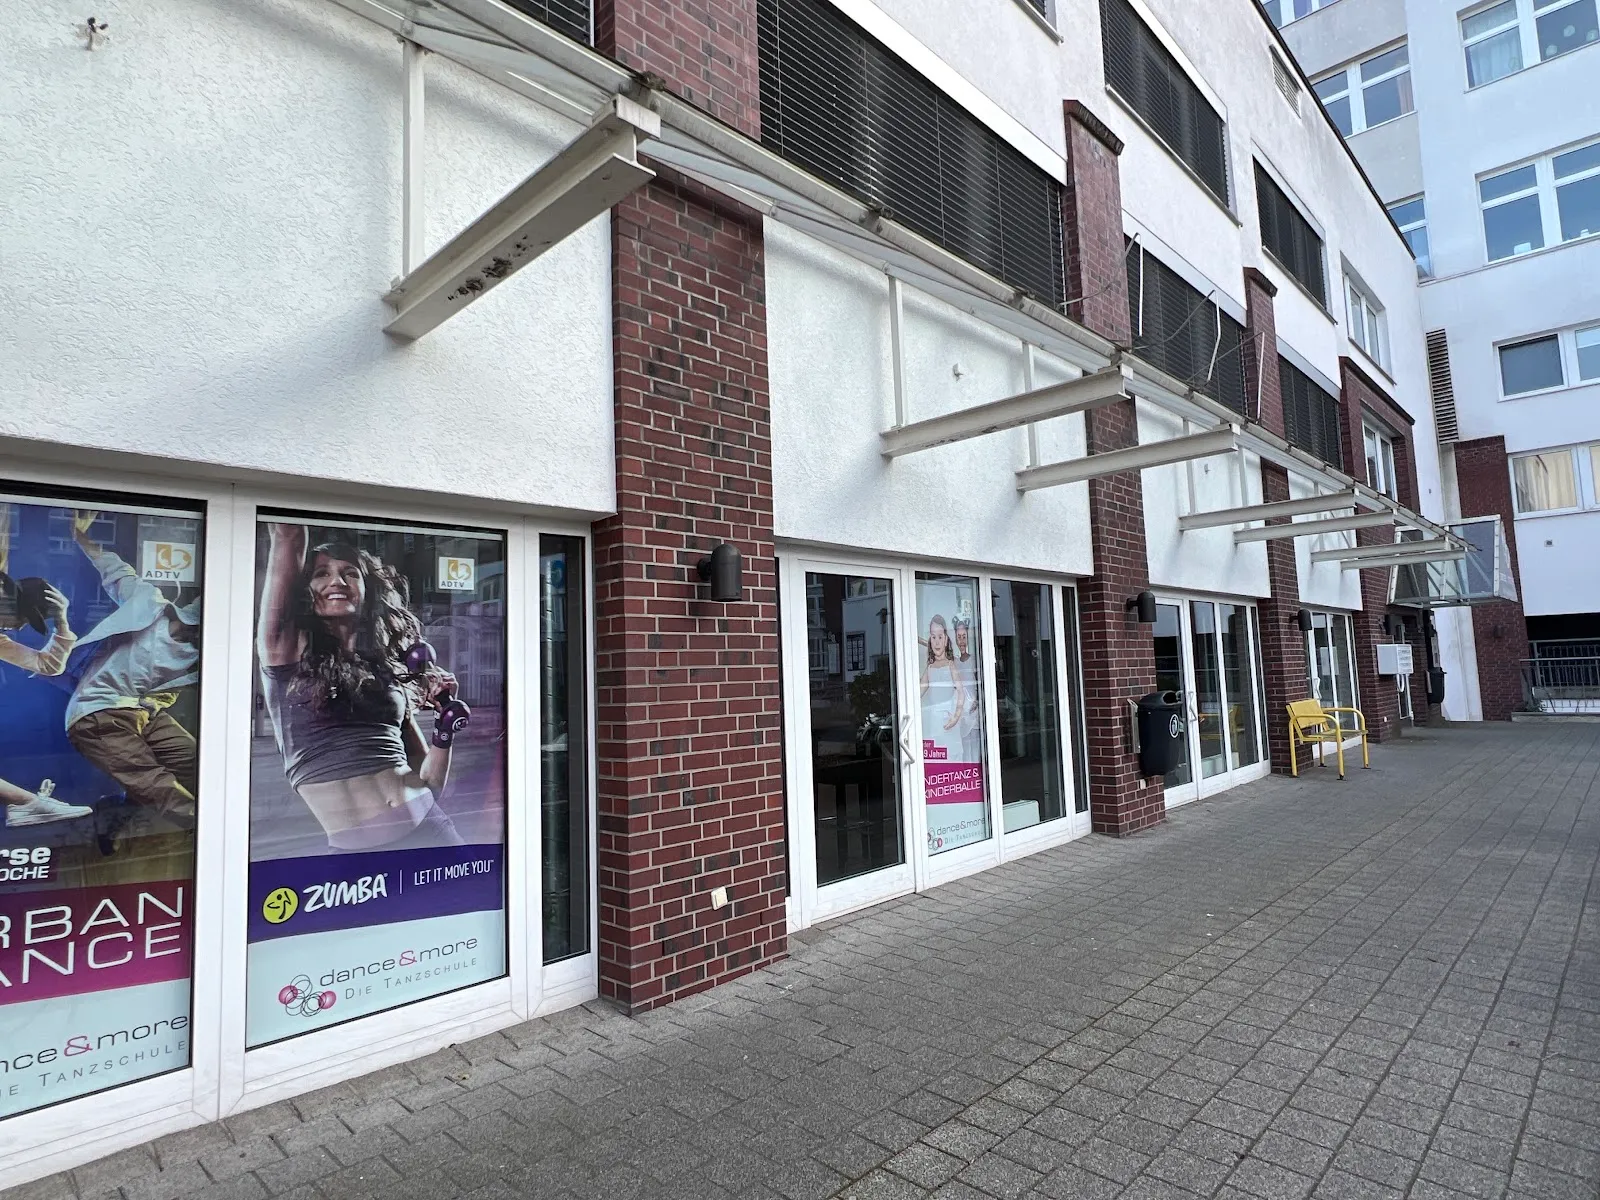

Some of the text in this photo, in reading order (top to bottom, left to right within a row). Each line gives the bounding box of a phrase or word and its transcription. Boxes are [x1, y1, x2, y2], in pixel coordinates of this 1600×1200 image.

[145, 570, 181, 579] ADTV
[440, 580, 465, 588] ADTV
[972, 768, 980, 778] &
[414, 869, 431, 886] LET
[433, 867, 442, 882] IT
[444, 862, 470, 880] MOVE
[0, 887, 183, 949] BAN
[0, 921, 182, 987] NCE
[319, 937, 478, 987] dance&more
